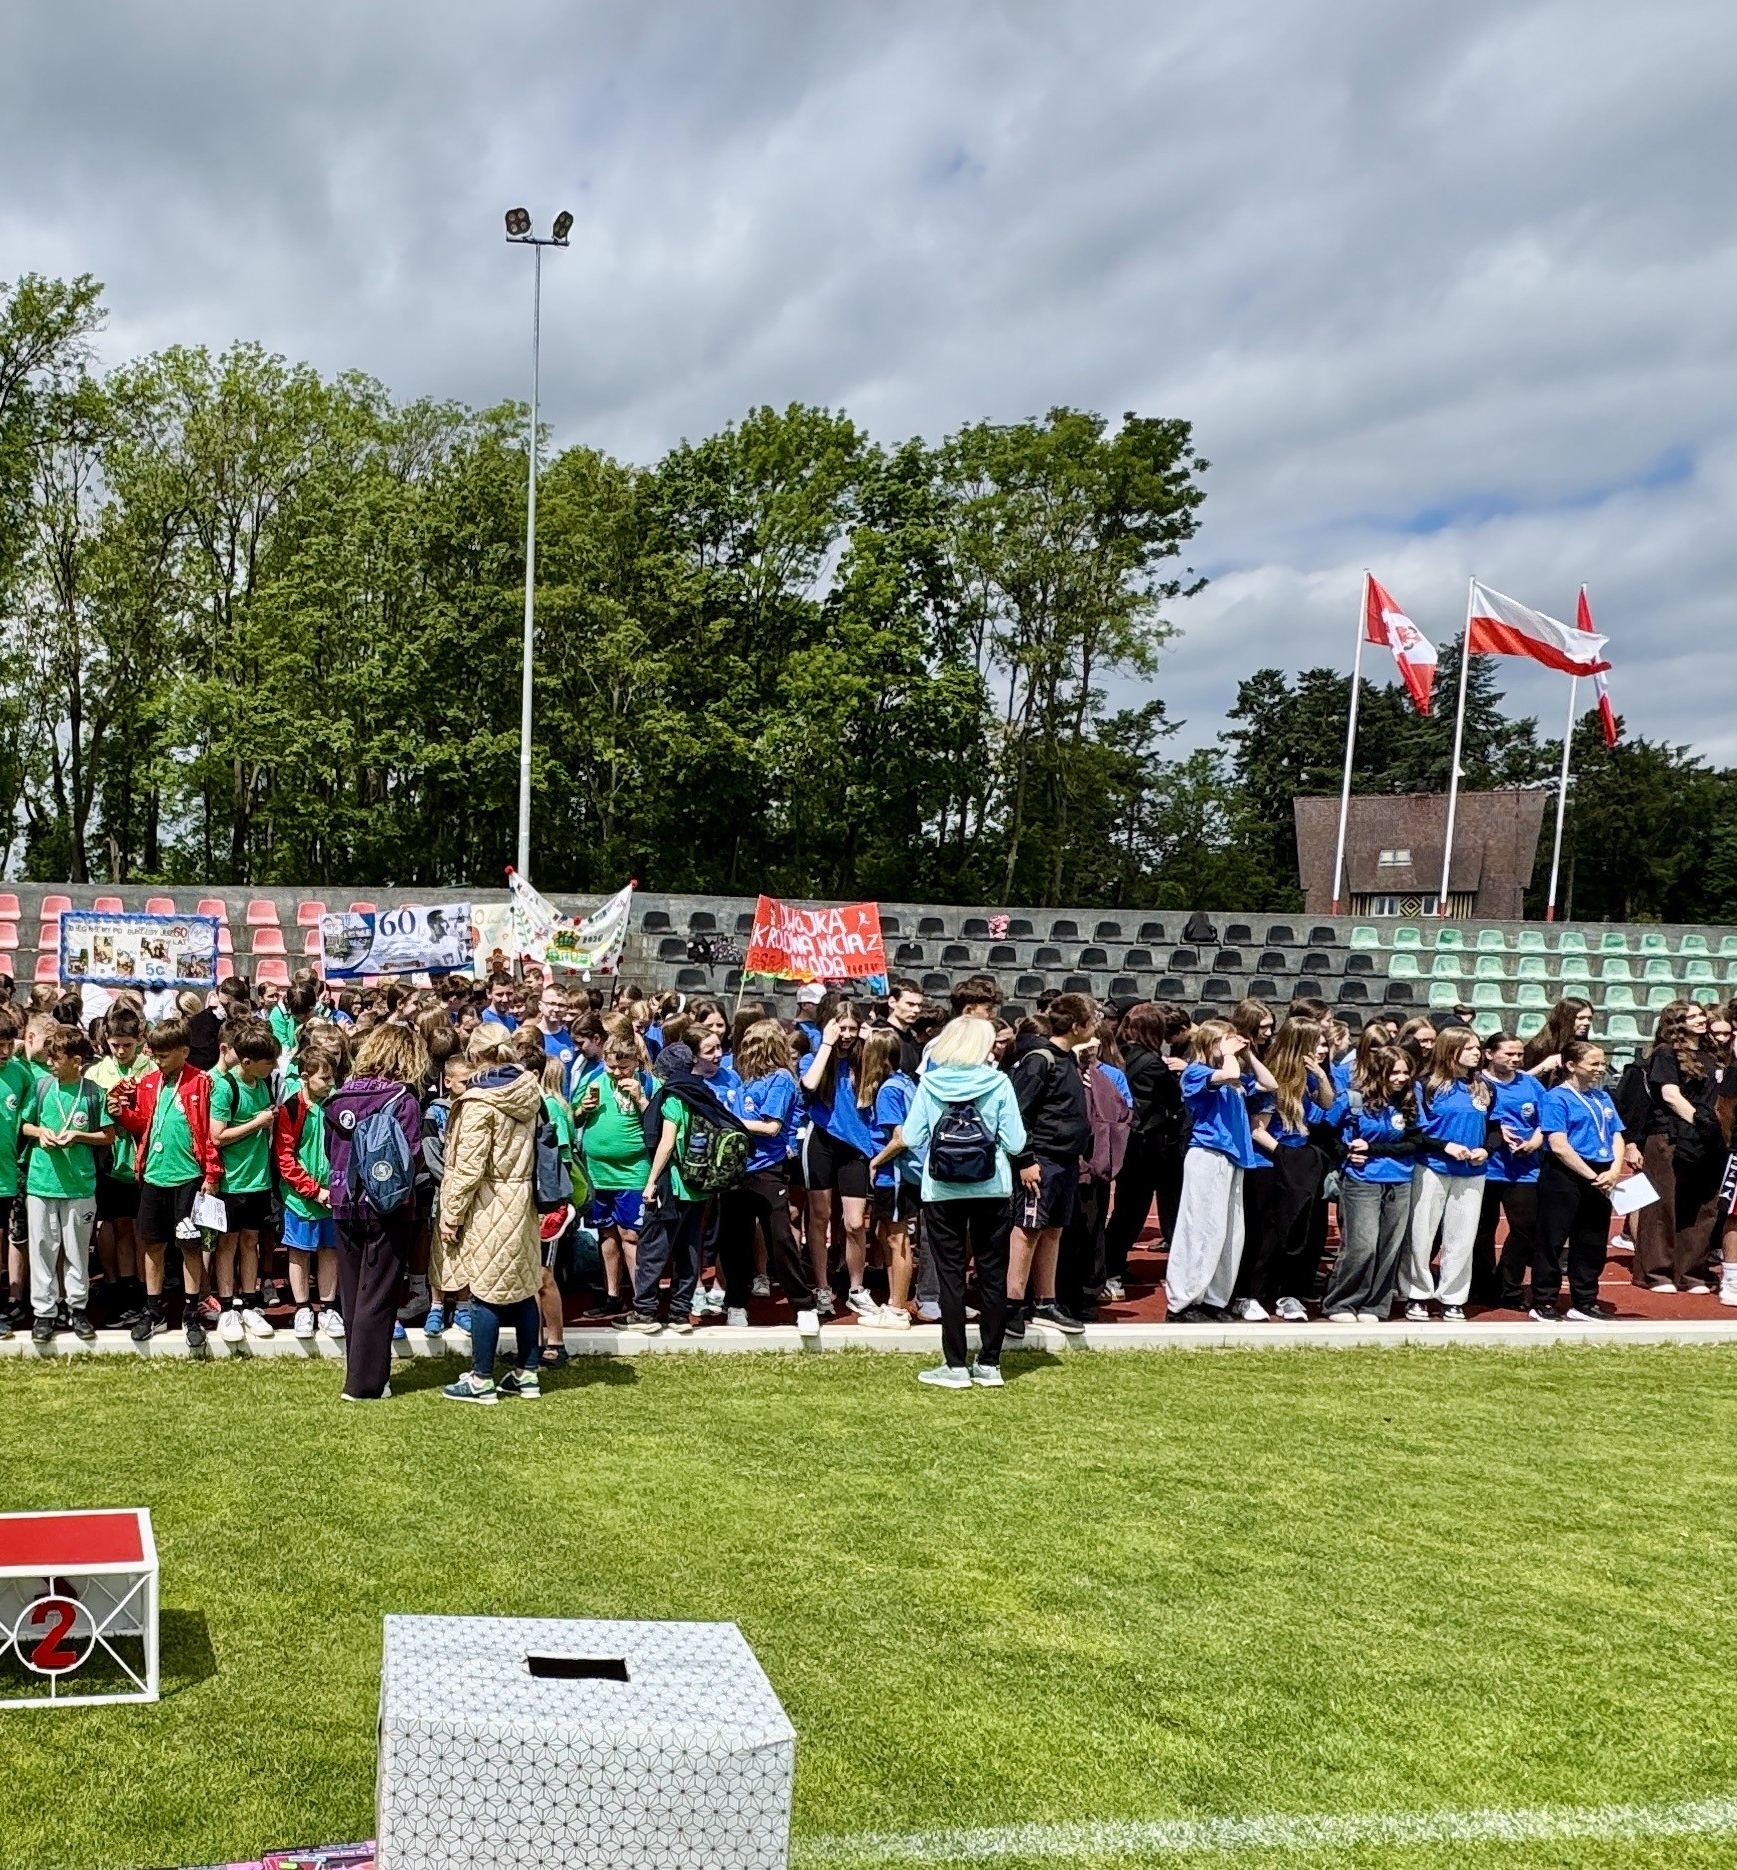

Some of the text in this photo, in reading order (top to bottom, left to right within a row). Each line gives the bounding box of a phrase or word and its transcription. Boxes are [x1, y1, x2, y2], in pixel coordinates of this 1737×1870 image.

[173, 926, 188, 938] 60
[379, 909, 416, 937] 60
[31, 1600, 77, 1668] 2
